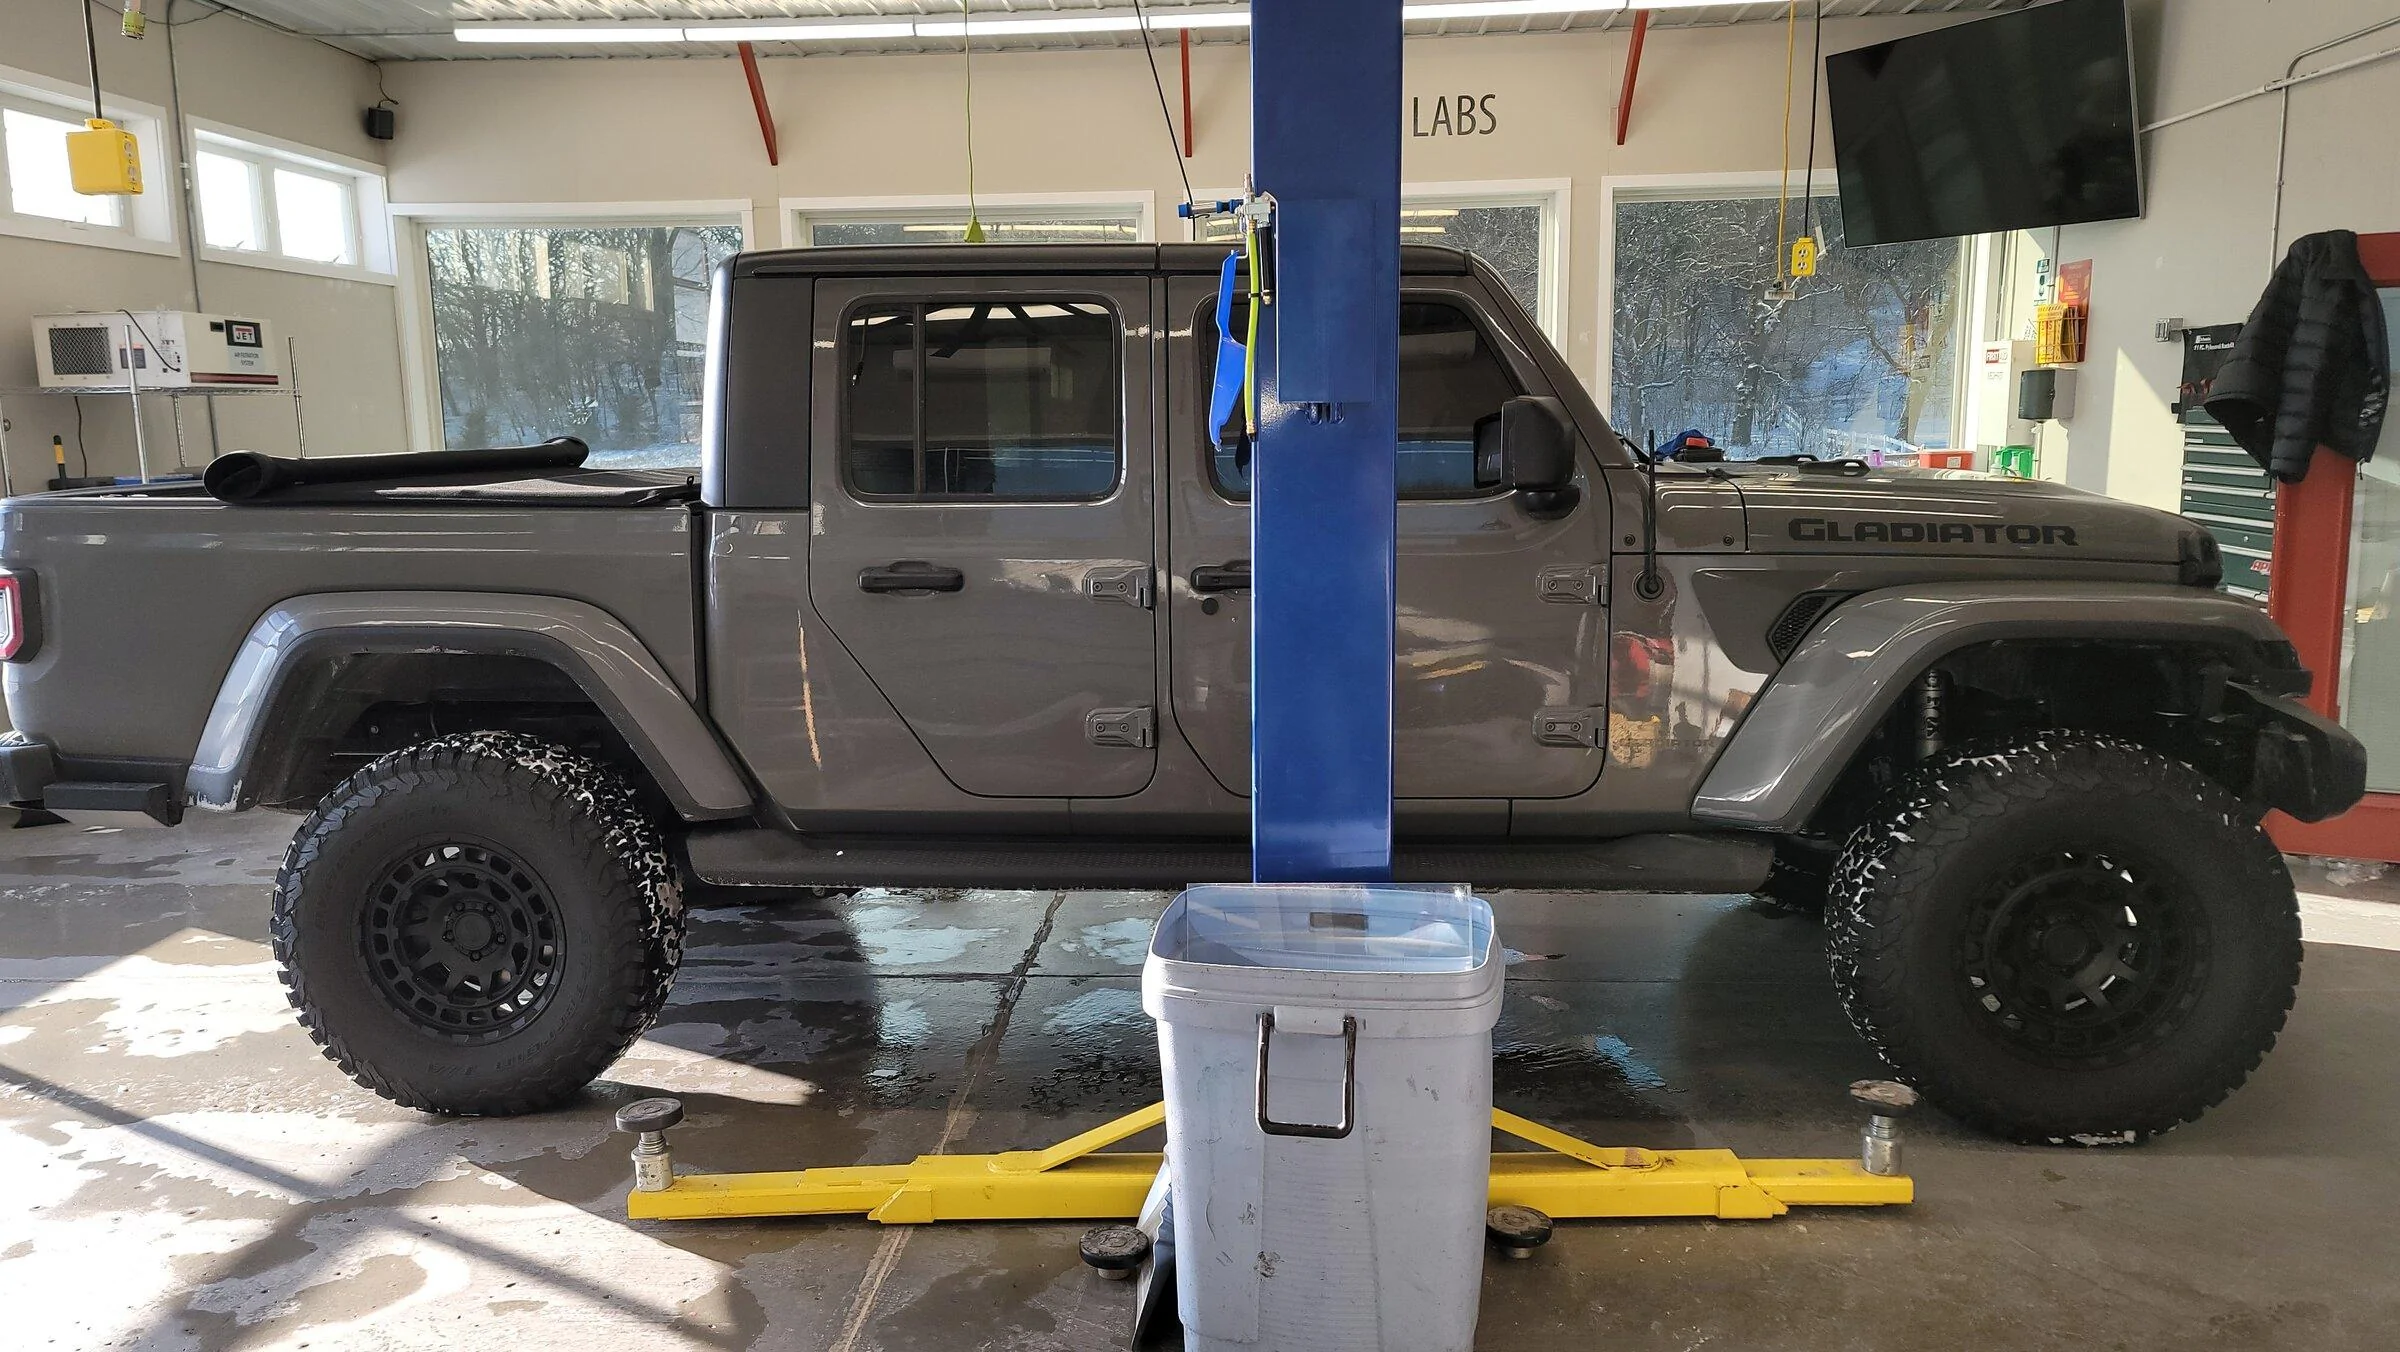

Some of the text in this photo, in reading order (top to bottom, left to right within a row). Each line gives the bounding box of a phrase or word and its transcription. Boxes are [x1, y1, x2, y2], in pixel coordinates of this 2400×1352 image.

[1412, 94, 1497, 137] LABS
[236, 332, 253, 341] JET
[1788, 518, 2079, 547] GLADIATOR
